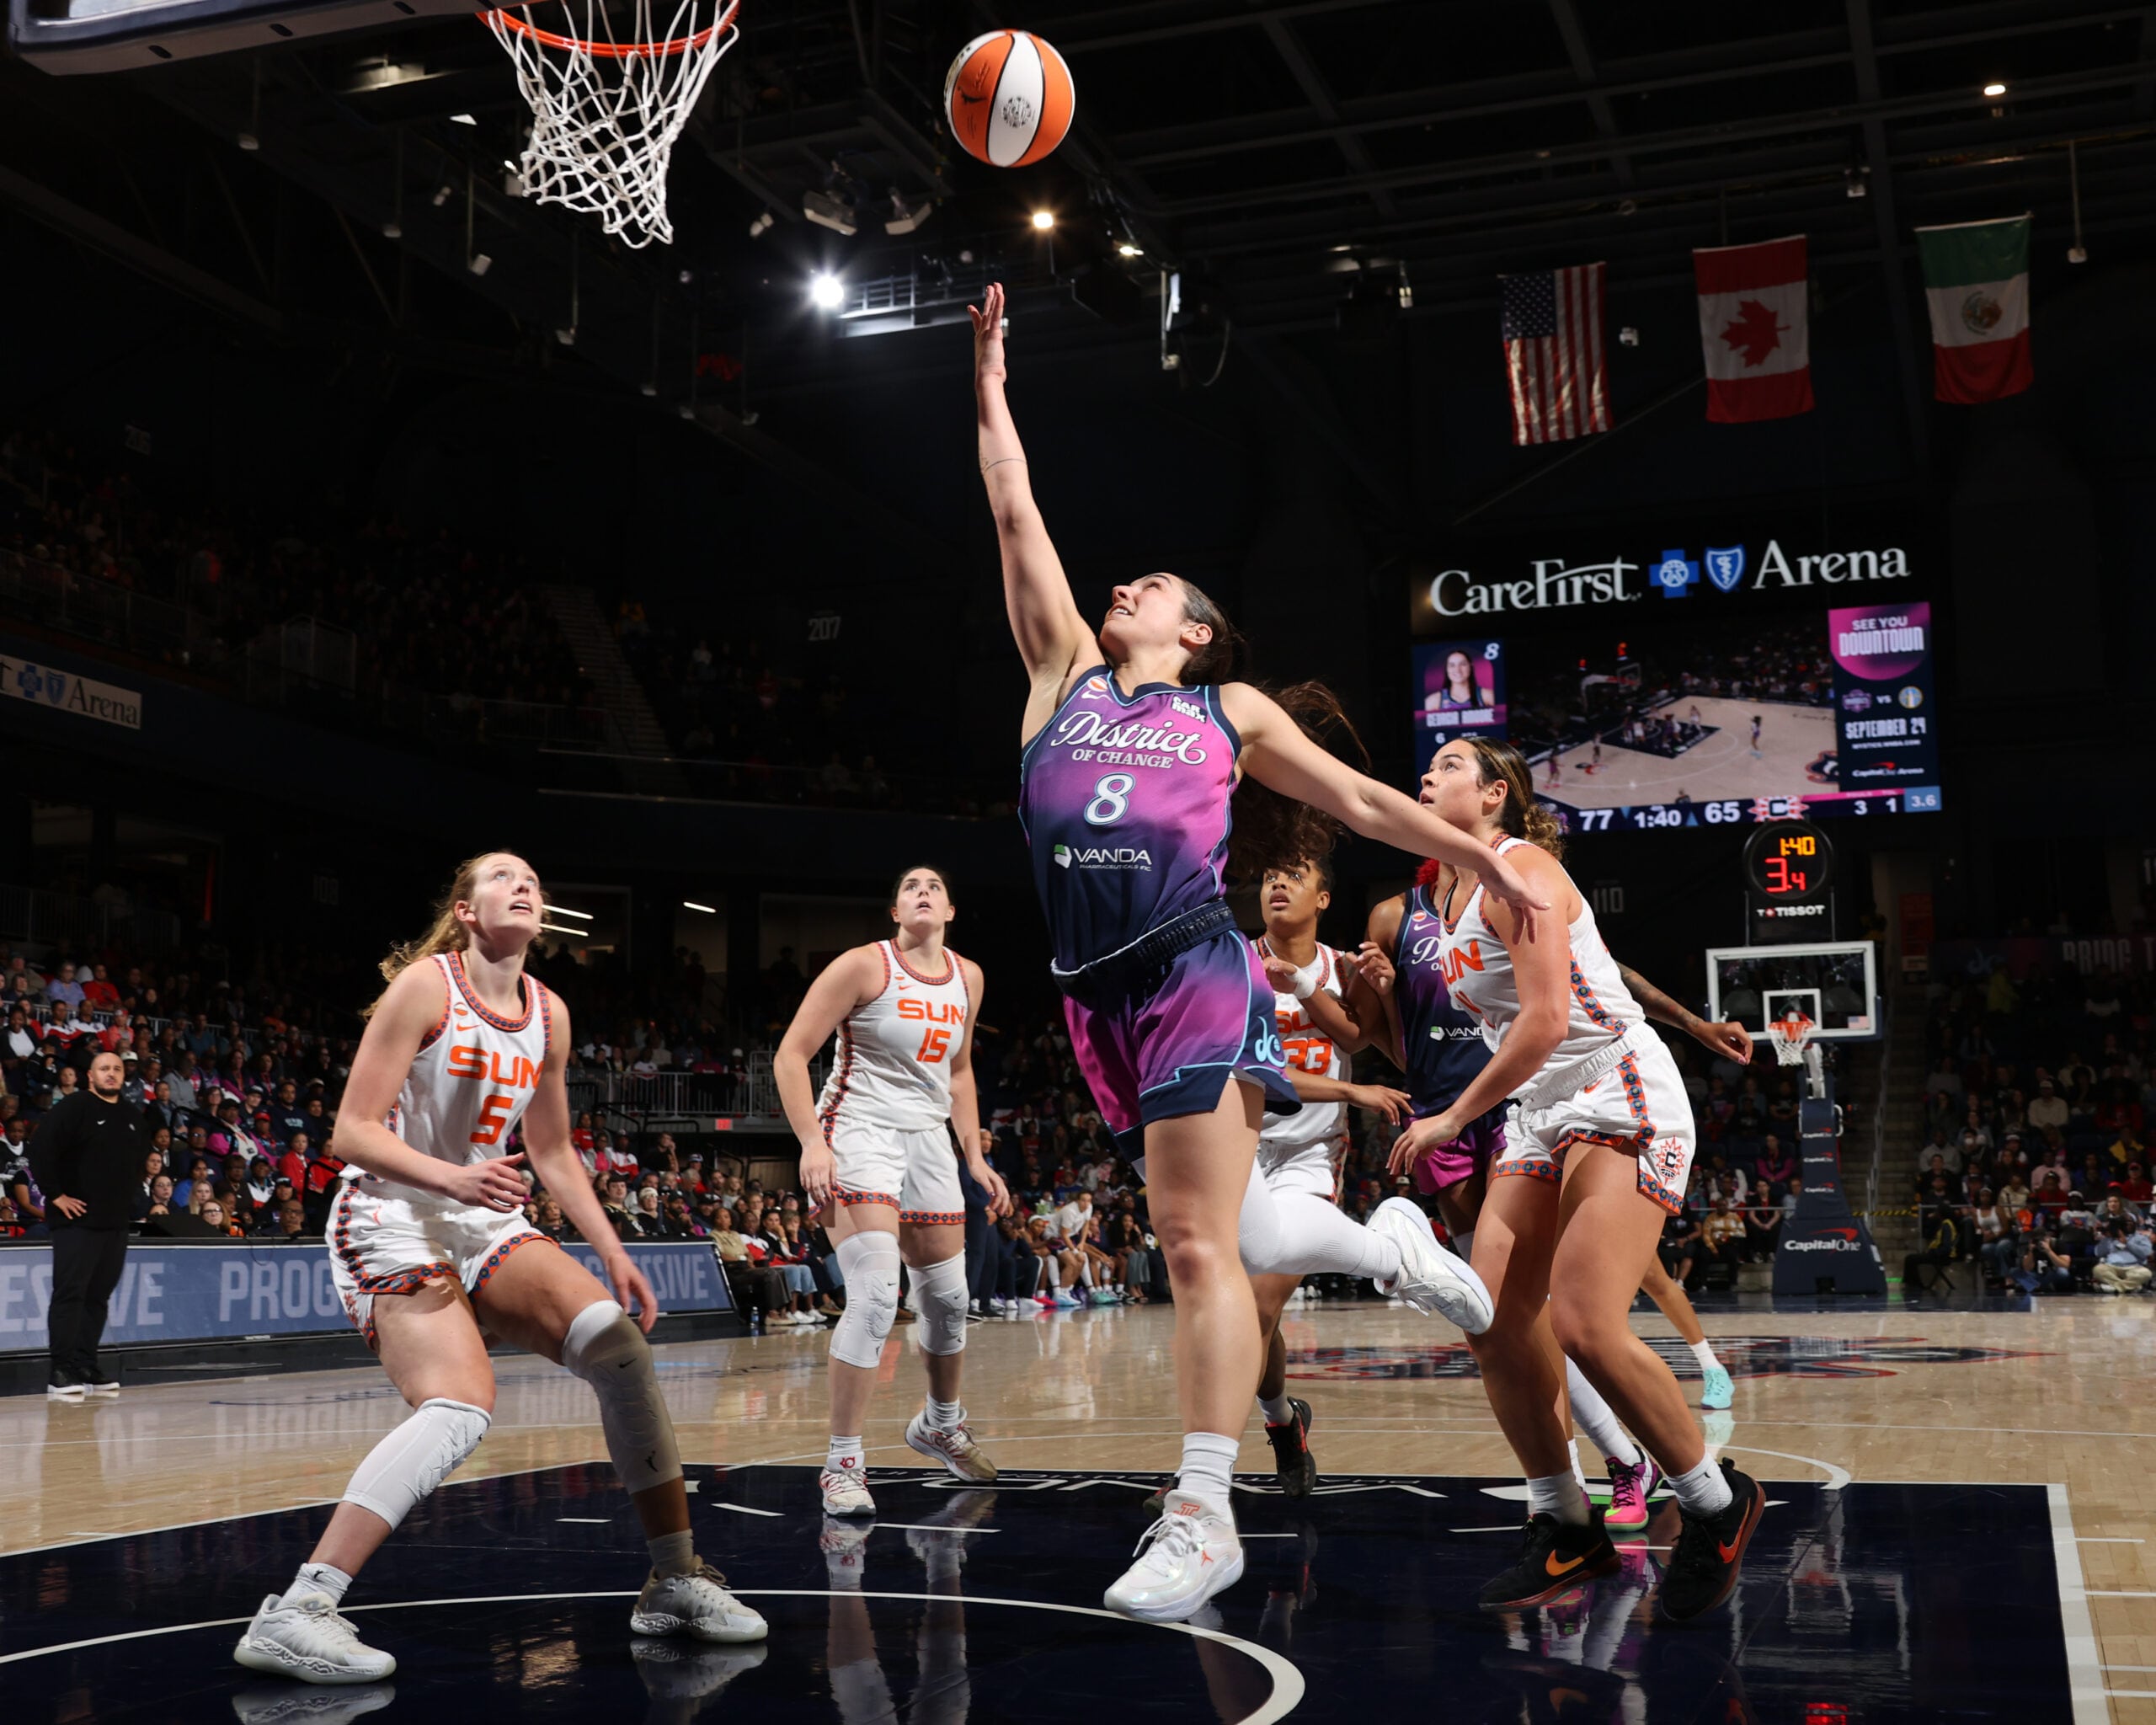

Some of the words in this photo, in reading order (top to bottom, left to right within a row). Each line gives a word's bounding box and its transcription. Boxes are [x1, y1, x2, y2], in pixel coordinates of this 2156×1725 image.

[1430, 555, 1640, 617] CareFirst
[1751, 540, 1912, 590] Arena
[1852, 617, 1877, 632] SEE
[1878, 615, 1908, 628] YOU
[1484, 643, 1500, 660] 8
[1838, 626, 1924, 657] DOWNTOWN
[68, 678, 139, 725] Arena
[1050, 711, 1207, 764] District
[1844, 718, 1908, 740] SEPTEMBER
[1909, 716, 1926, 734] 24
[1071, 748, 1097, 761] OF
[1097, 750, 1174, 770] CHANGE
[1083, 772, 1136, 825] 8
[1578, 809, 1614, 831] 77
[1634, 809, 1682, 829] 1:40
[1705, 801, 1741, 824] 65
[1854, 799, 1868, 815] 3
[1886, 798, 1897, 813] 1
[1910, 794, 1936, 809] 3.6
[1073, 848, 1153, 865] VANDA
[1780, 836, 1816, 857] 1:40
[1765, 857, 1806, 893] 3.4
[1775, 905, 1825, 917] TISSOT
[1441, 939, 1485, 987] UN
[897, 999, 966, 1026] SUN
[916, 1028, 951, 1063] 15
[447, 1045, 545, 1089] SUN
[469, 1094, 514, 1146] 5
[1784, 1238, 1862, 1252] CapitalOne
